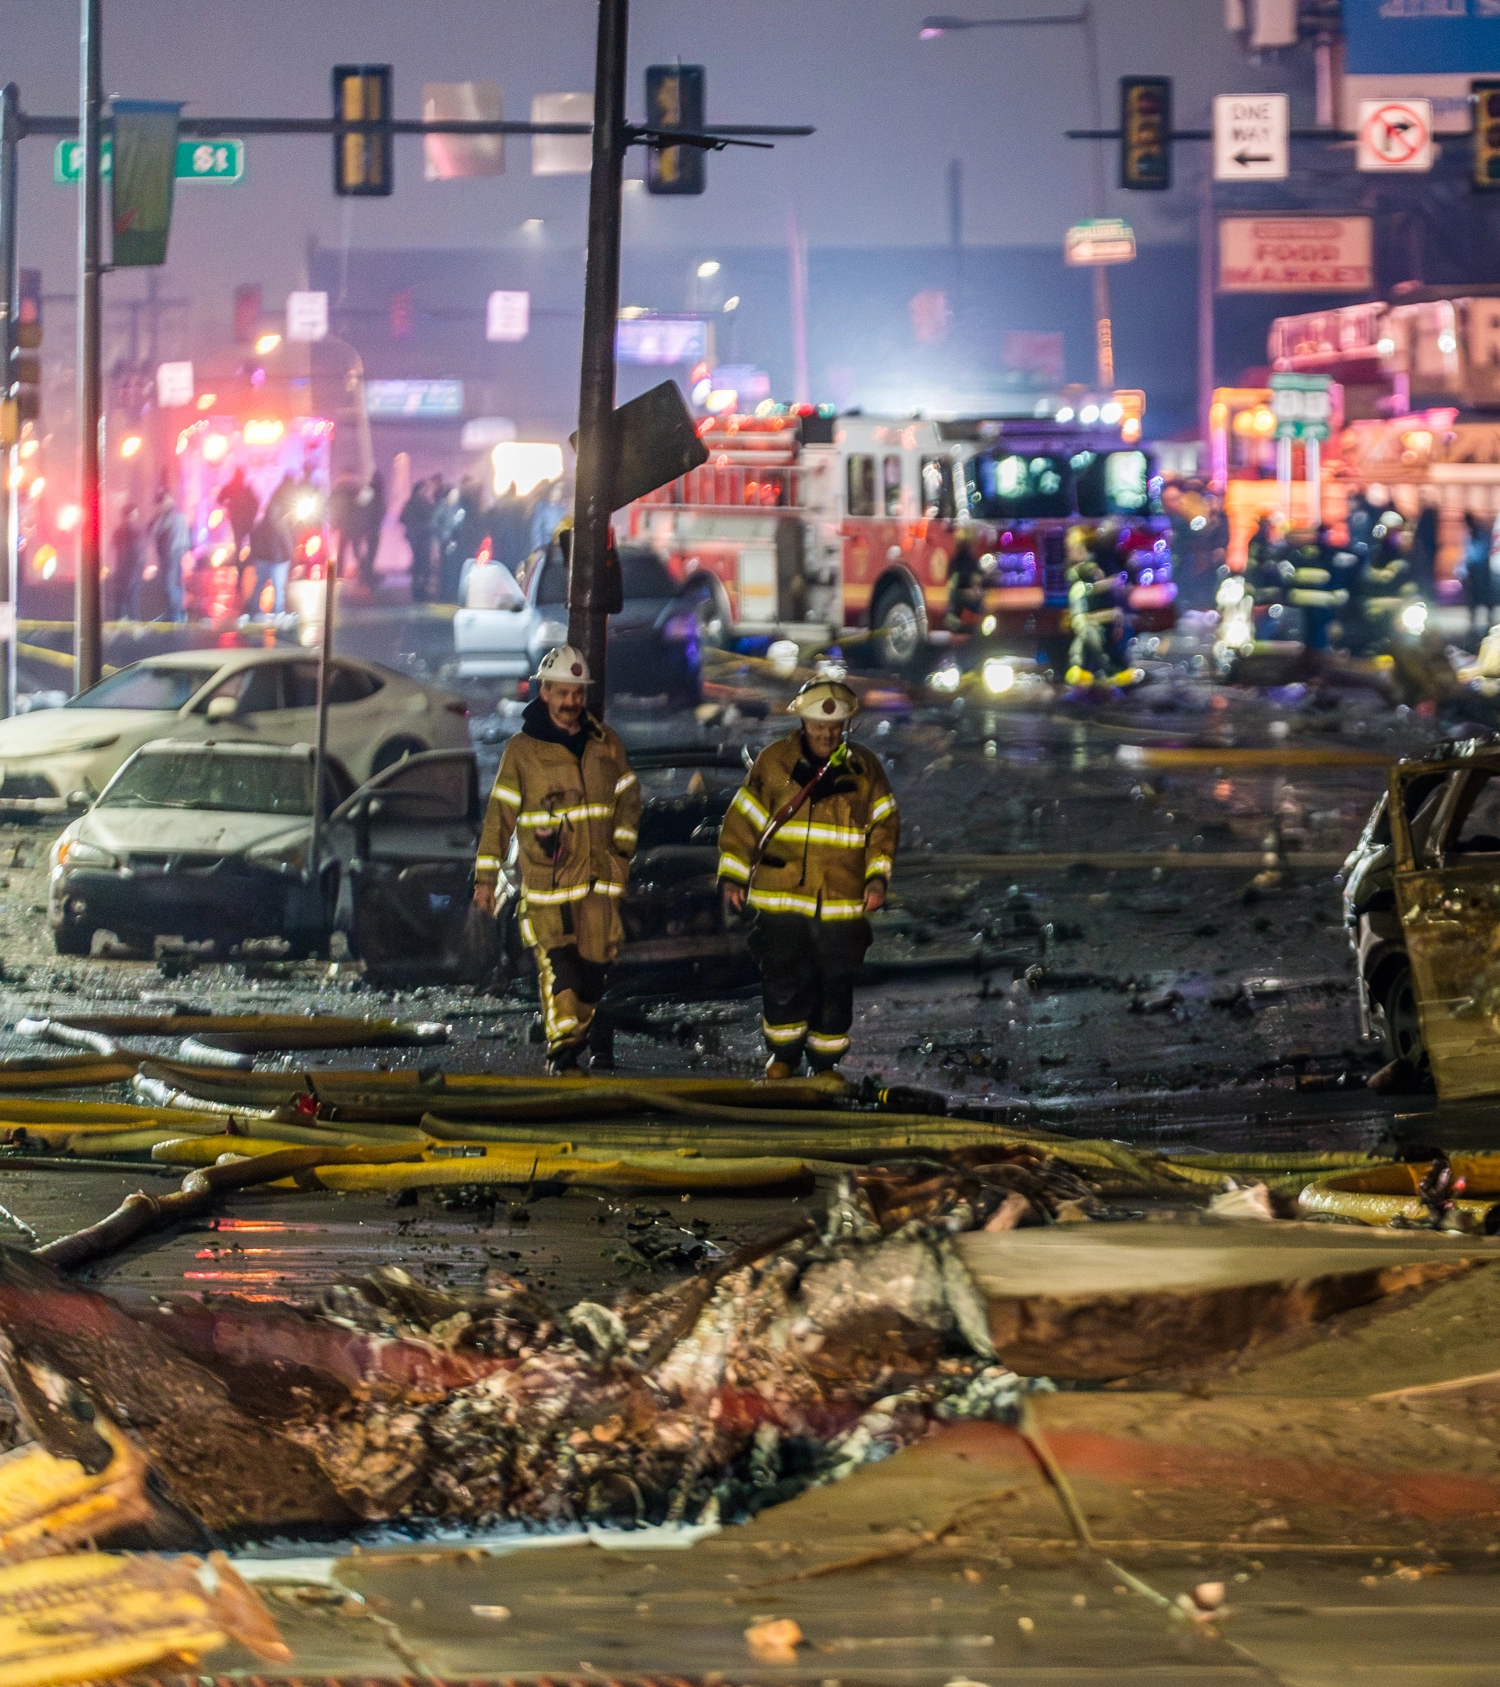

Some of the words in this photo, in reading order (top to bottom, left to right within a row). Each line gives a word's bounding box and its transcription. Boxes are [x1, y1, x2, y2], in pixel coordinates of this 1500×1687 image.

[1231, 103, 1271, 121] ONE
[1231, 127, 1270, 142] WAY
[192, 145, 229, 173] St
[1254, 243, 1341, 262] FOOD
[1222, 265, 1367, 284] MARKET
